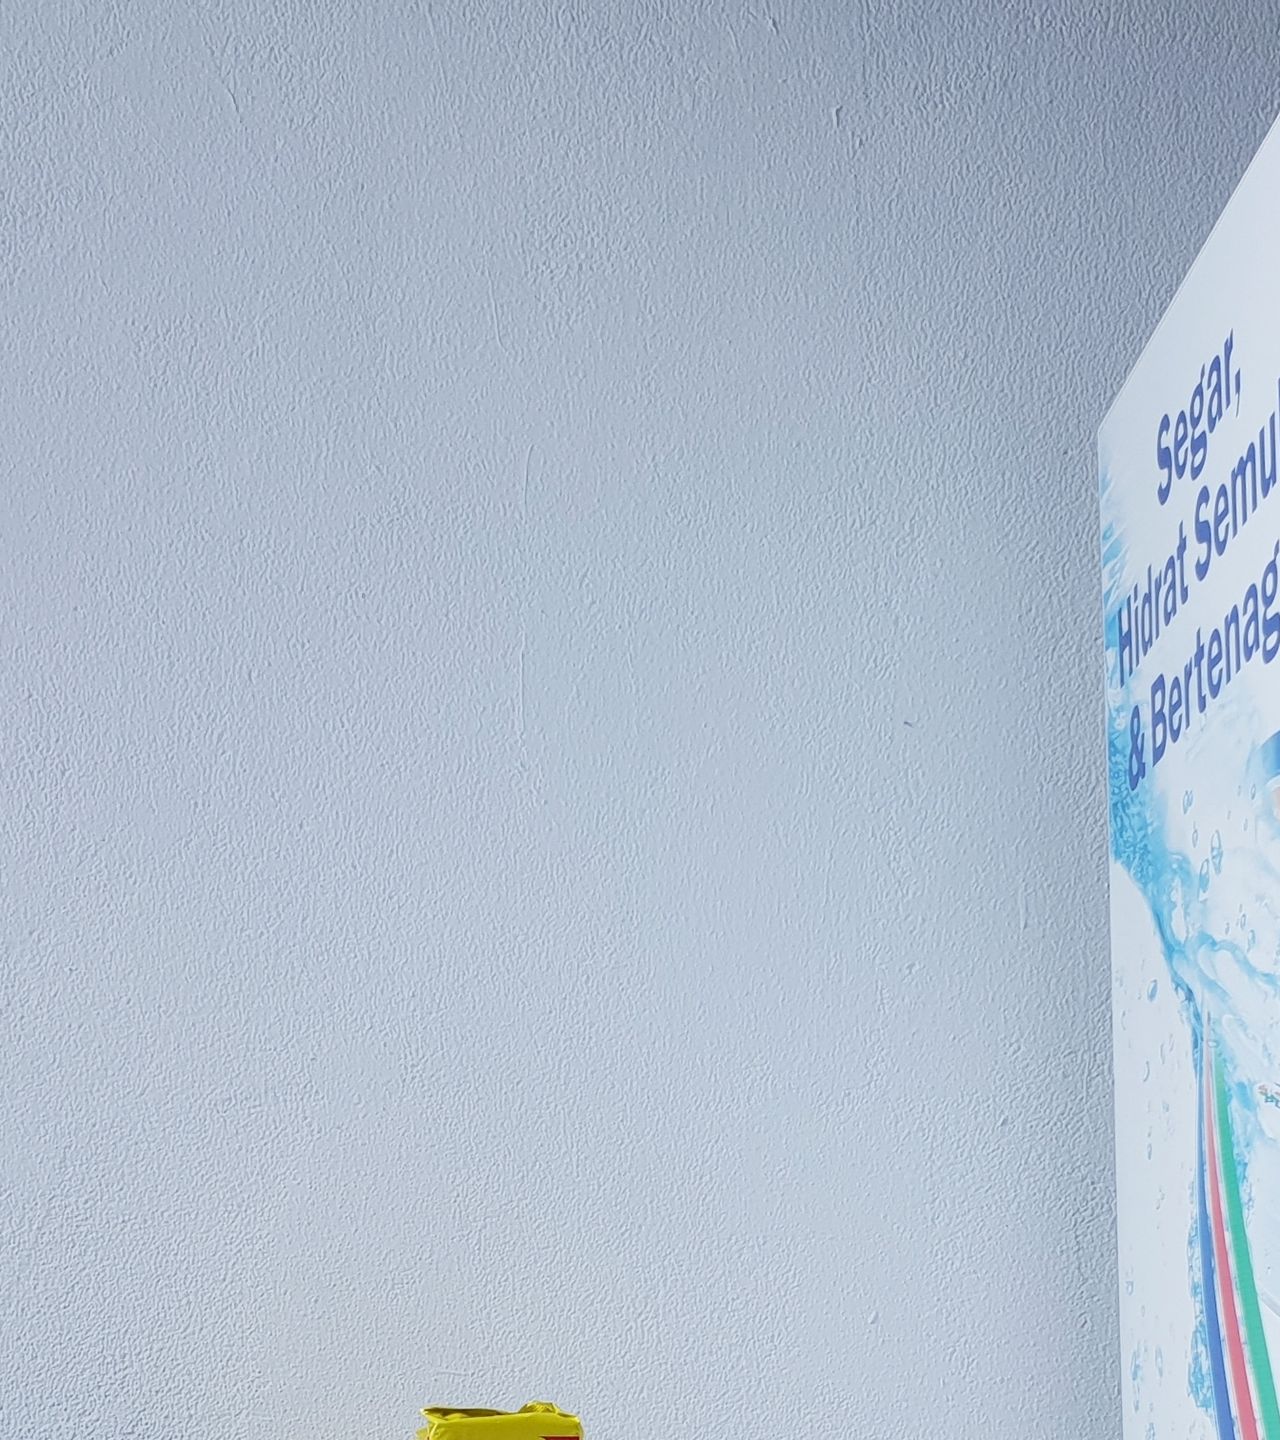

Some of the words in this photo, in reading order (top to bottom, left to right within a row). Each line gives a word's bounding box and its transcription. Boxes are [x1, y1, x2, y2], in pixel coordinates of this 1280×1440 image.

[1157, 328, 1241, 506] Segar,
[1119, 520, 1189, 688] Hidrat
[1128, 704, 1146, 792] &
